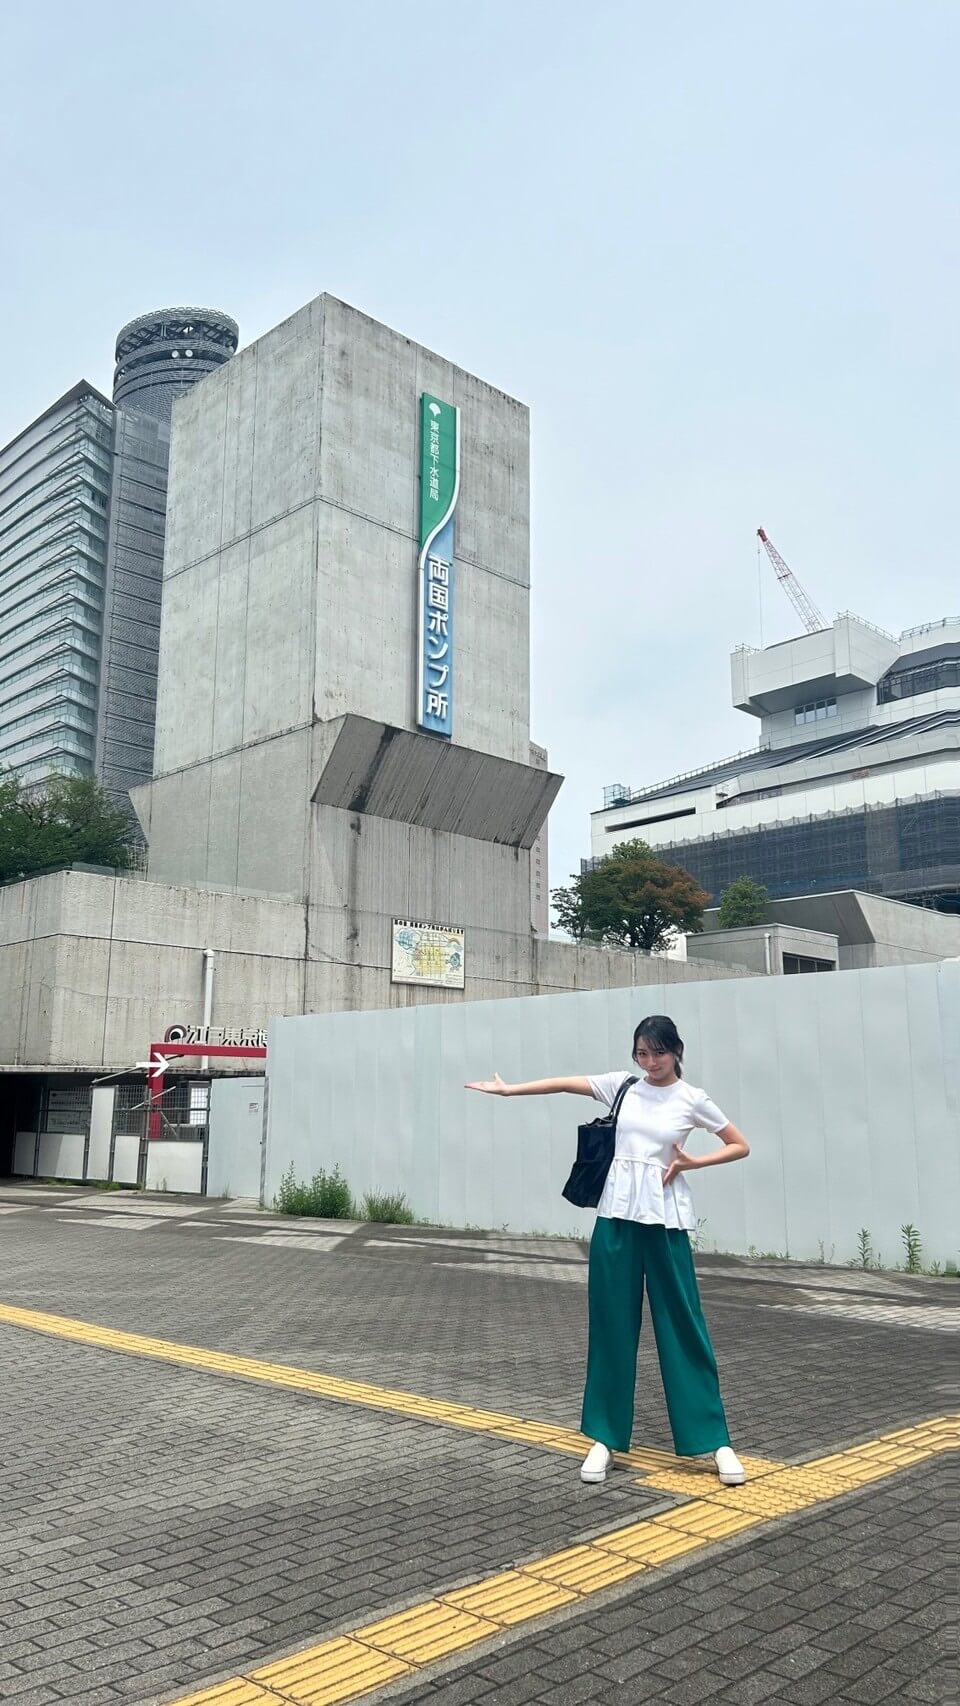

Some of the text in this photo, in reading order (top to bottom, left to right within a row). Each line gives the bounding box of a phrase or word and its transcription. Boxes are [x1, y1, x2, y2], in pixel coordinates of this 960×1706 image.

[430, 420, 439, 501] 東京都下水道局
[427, 555, 450, 718] 両国ポンプ所
